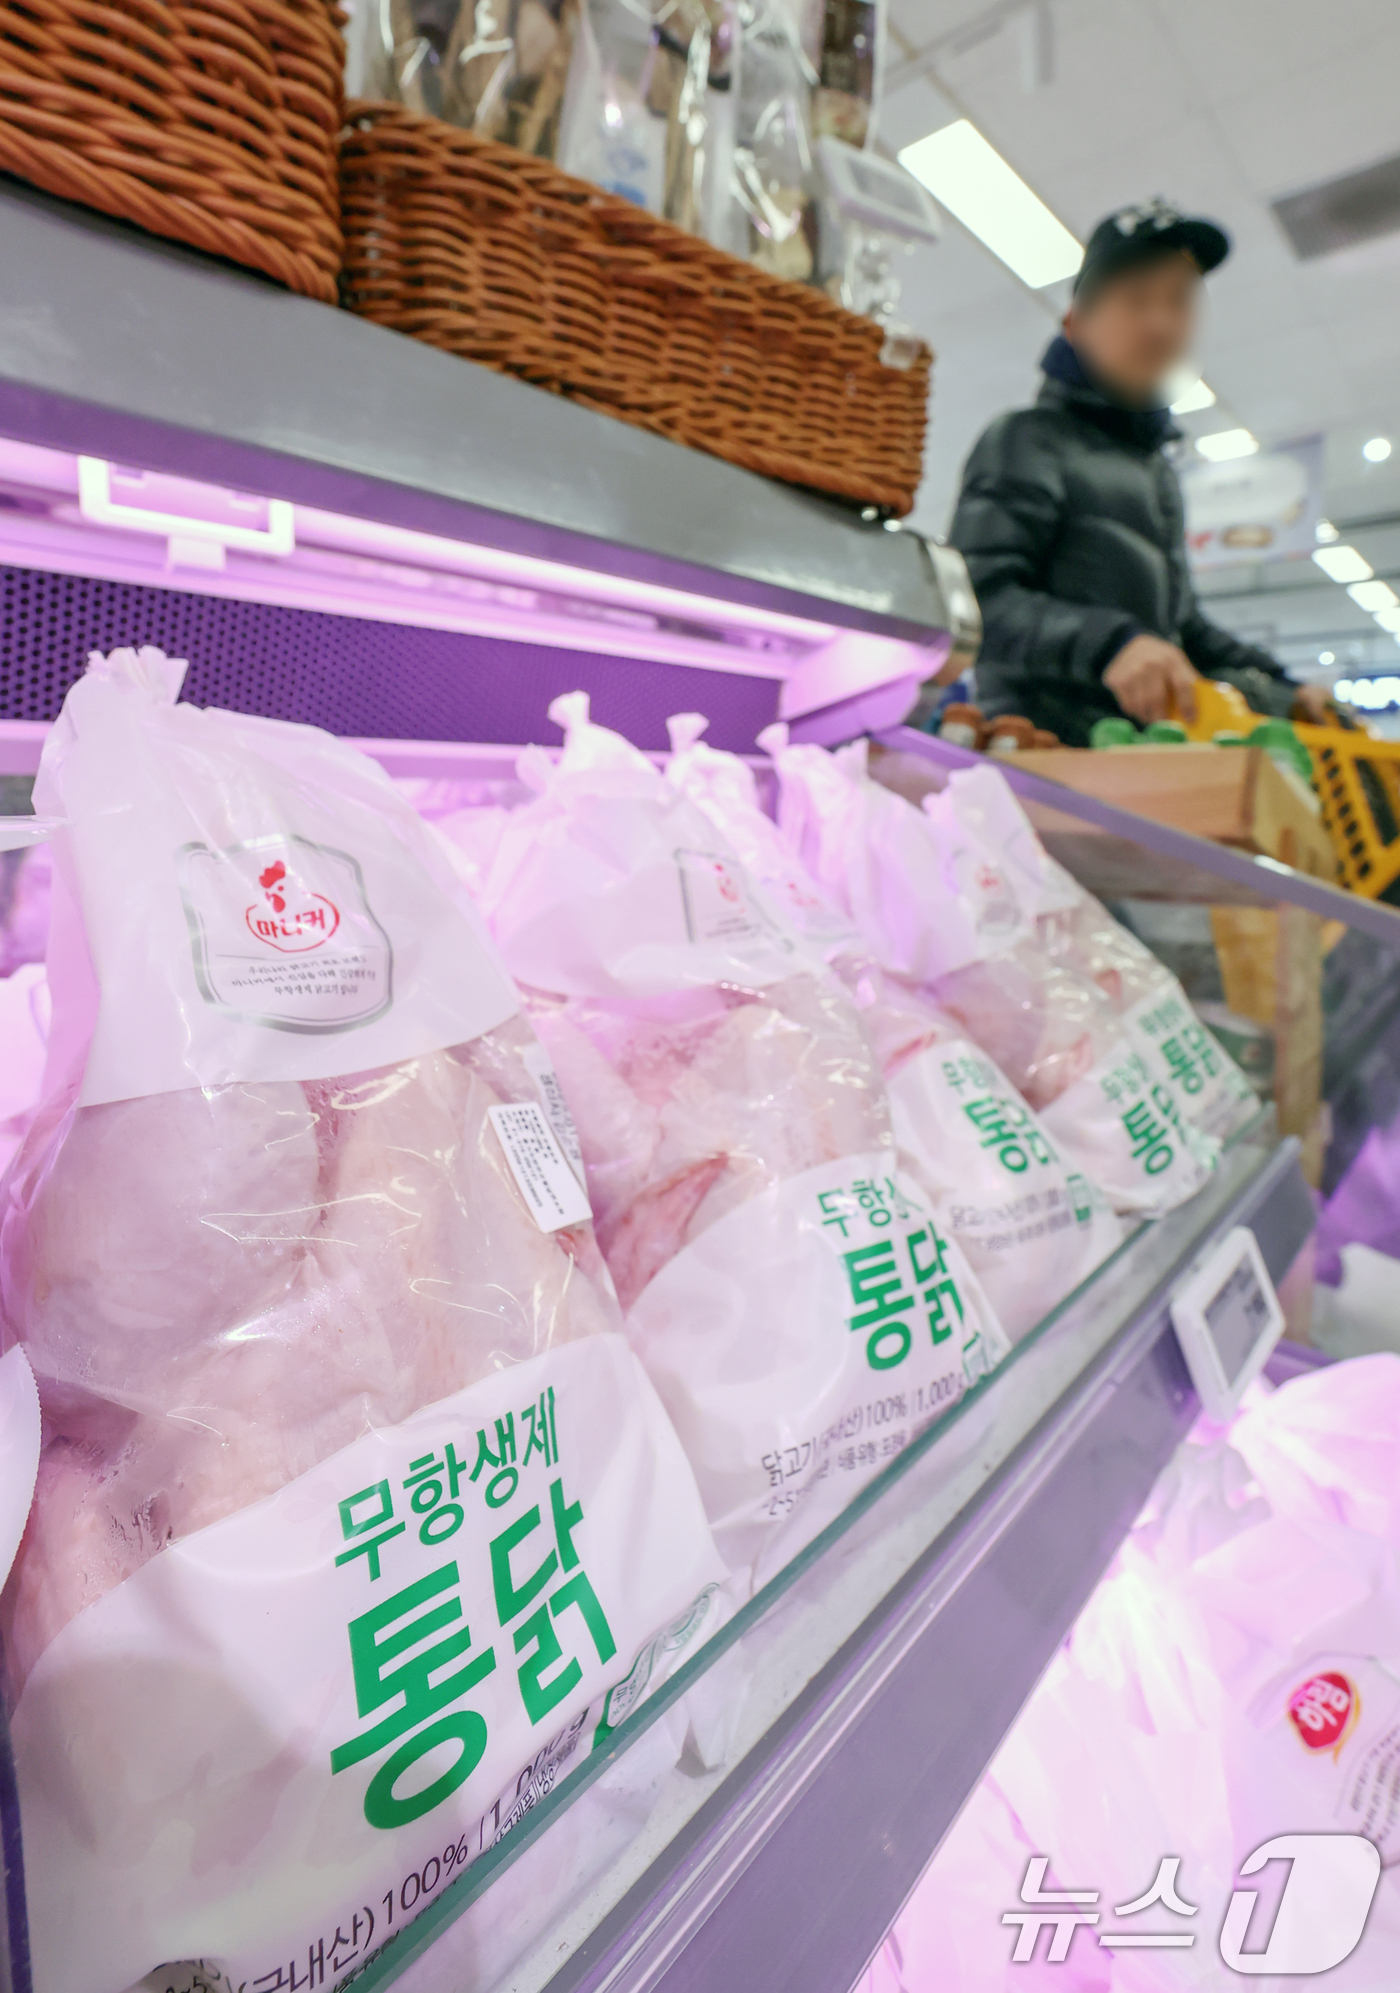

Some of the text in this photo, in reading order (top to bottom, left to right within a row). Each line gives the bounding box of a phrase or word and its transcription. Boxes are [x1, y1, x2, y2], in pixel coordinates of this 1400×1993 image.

[256, 908, 327, 939] 마니커
[842, 1220, 967, 1371] 통닭
[334, 1385, 562, 1583] 무항생제
[330, 1477, 617, 1830] 통닭
